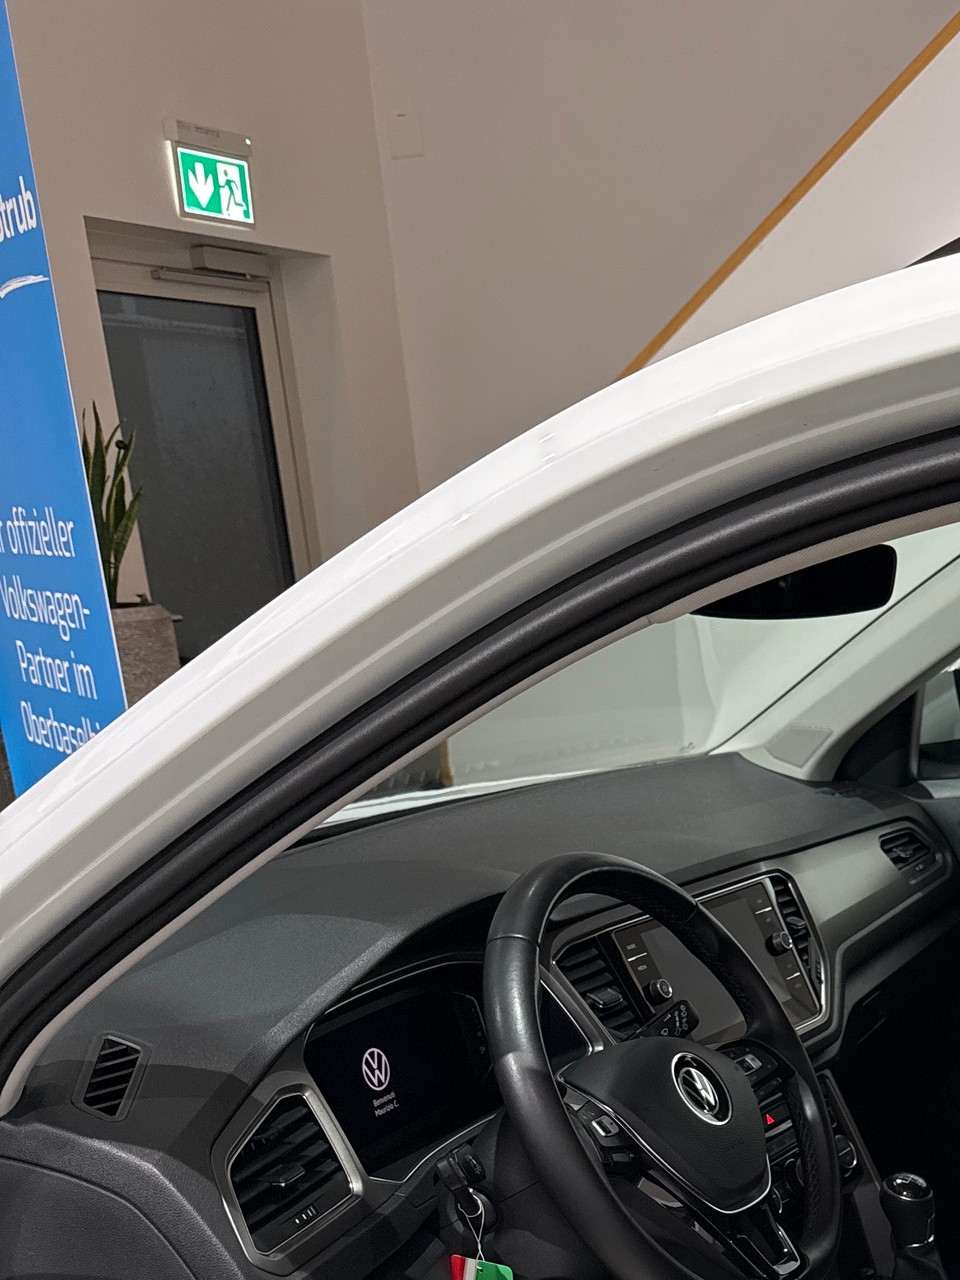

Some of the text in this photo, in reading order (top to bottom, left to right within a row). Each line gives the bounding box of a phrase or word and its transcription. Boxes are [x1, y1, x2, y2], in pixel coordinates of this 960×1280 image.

[0, 175, 37, 243] trub
[6, 506, 75, 558] offizieller
[0, 574, 91, 641] Volkswagen-
[15, 640, 98, 700] Partner im
